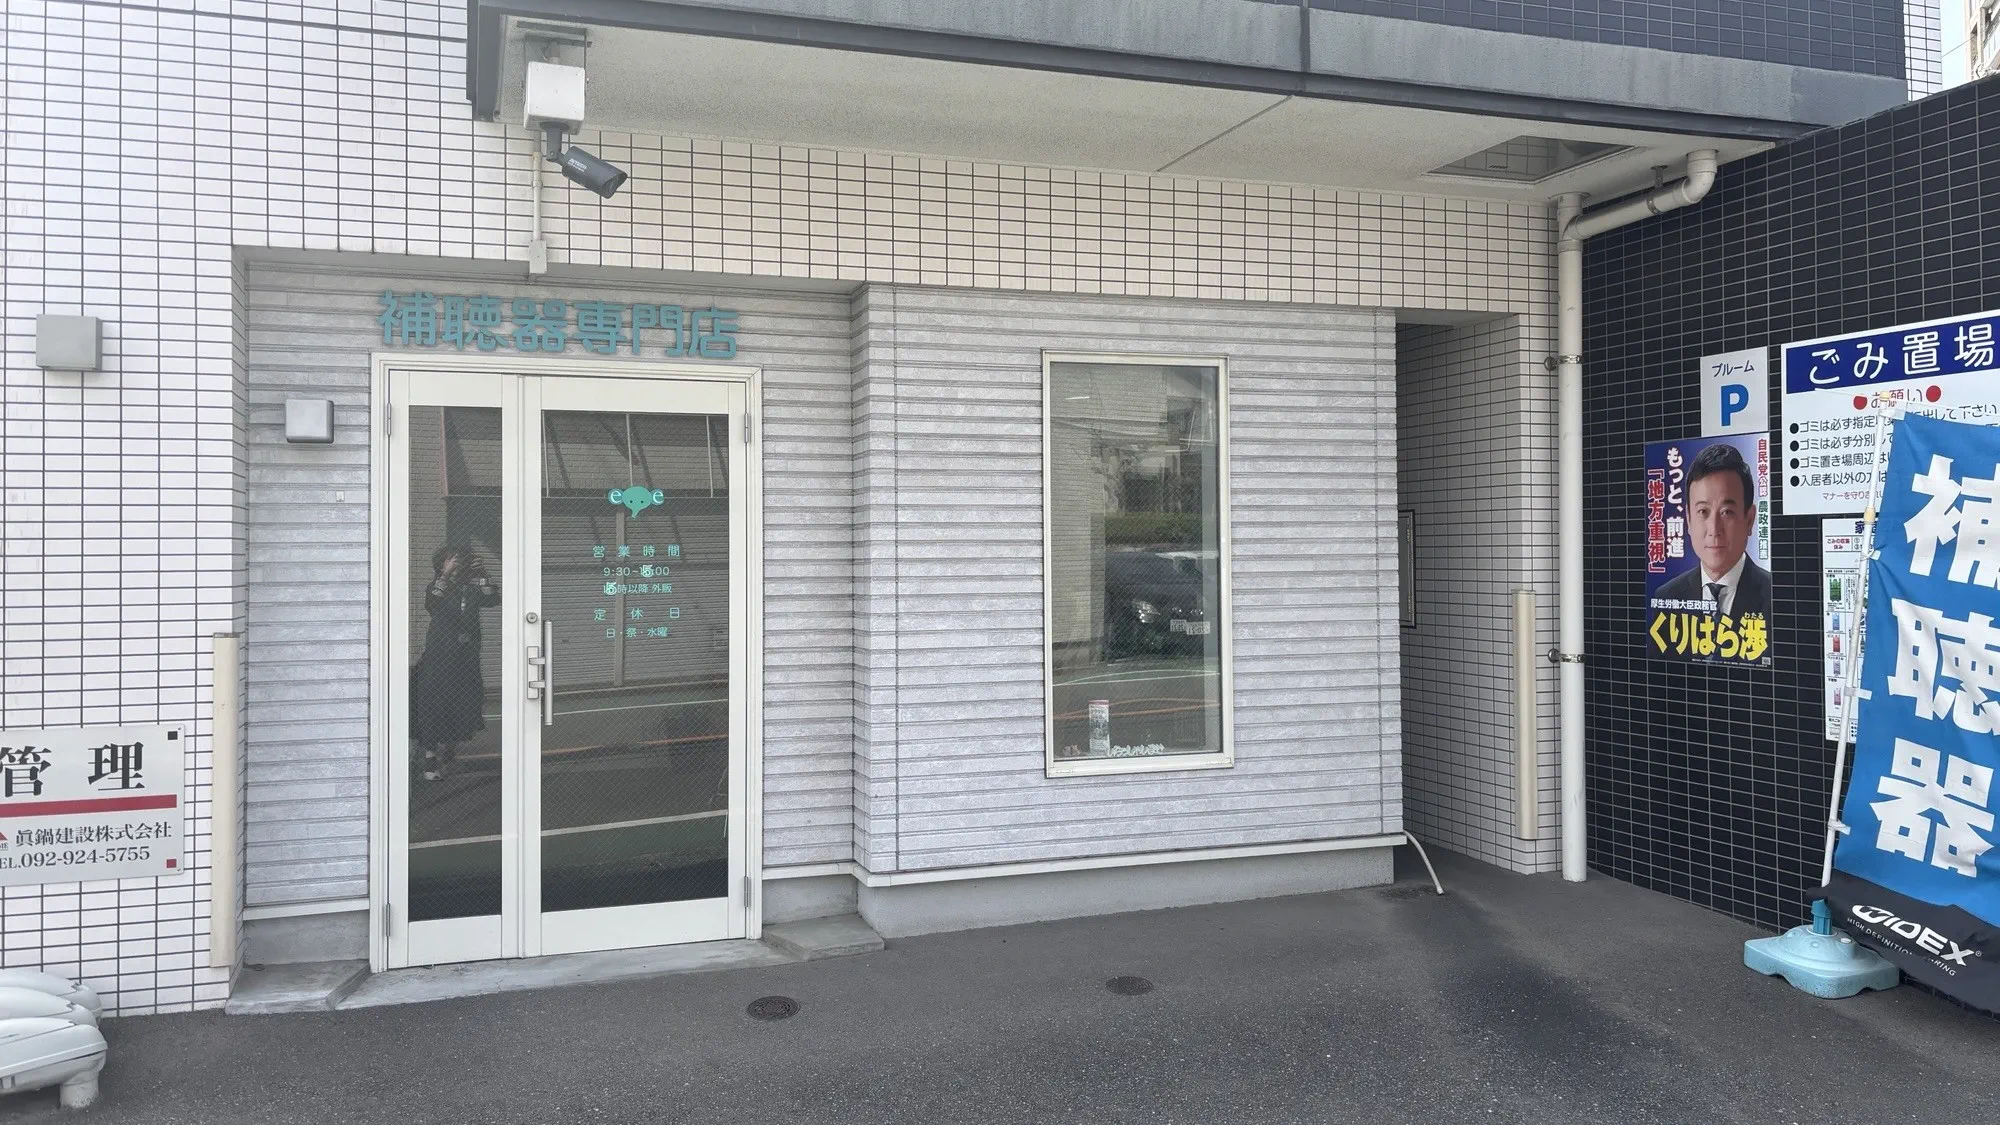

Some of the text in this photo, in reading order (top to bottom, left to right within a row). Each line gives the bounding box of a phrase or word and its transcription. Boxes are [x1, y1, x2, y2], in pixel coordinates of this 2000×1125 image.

[376, 289, 740, 359] 補聴器専門店
[1711, 360, 1755, 378] ブルーム
[1809, 323, 1995, 385] ごみ置場
[1720, 384, 1749, 427] P
[1666, 447, 1685, 558] もっと、前進
[592, 545, 681, 558] 営業時間
[593, 607, 680, 621] 定休日
[1649, 611, 1768, 661] くりはら渉
[1869, 453, 2000, 879] 補聴器
[0, 741, 145, 798] 管理
[0, 845, 150, 869] EL.092-924-5755
[1865, 928, 1913, 955] DEFINITIO
